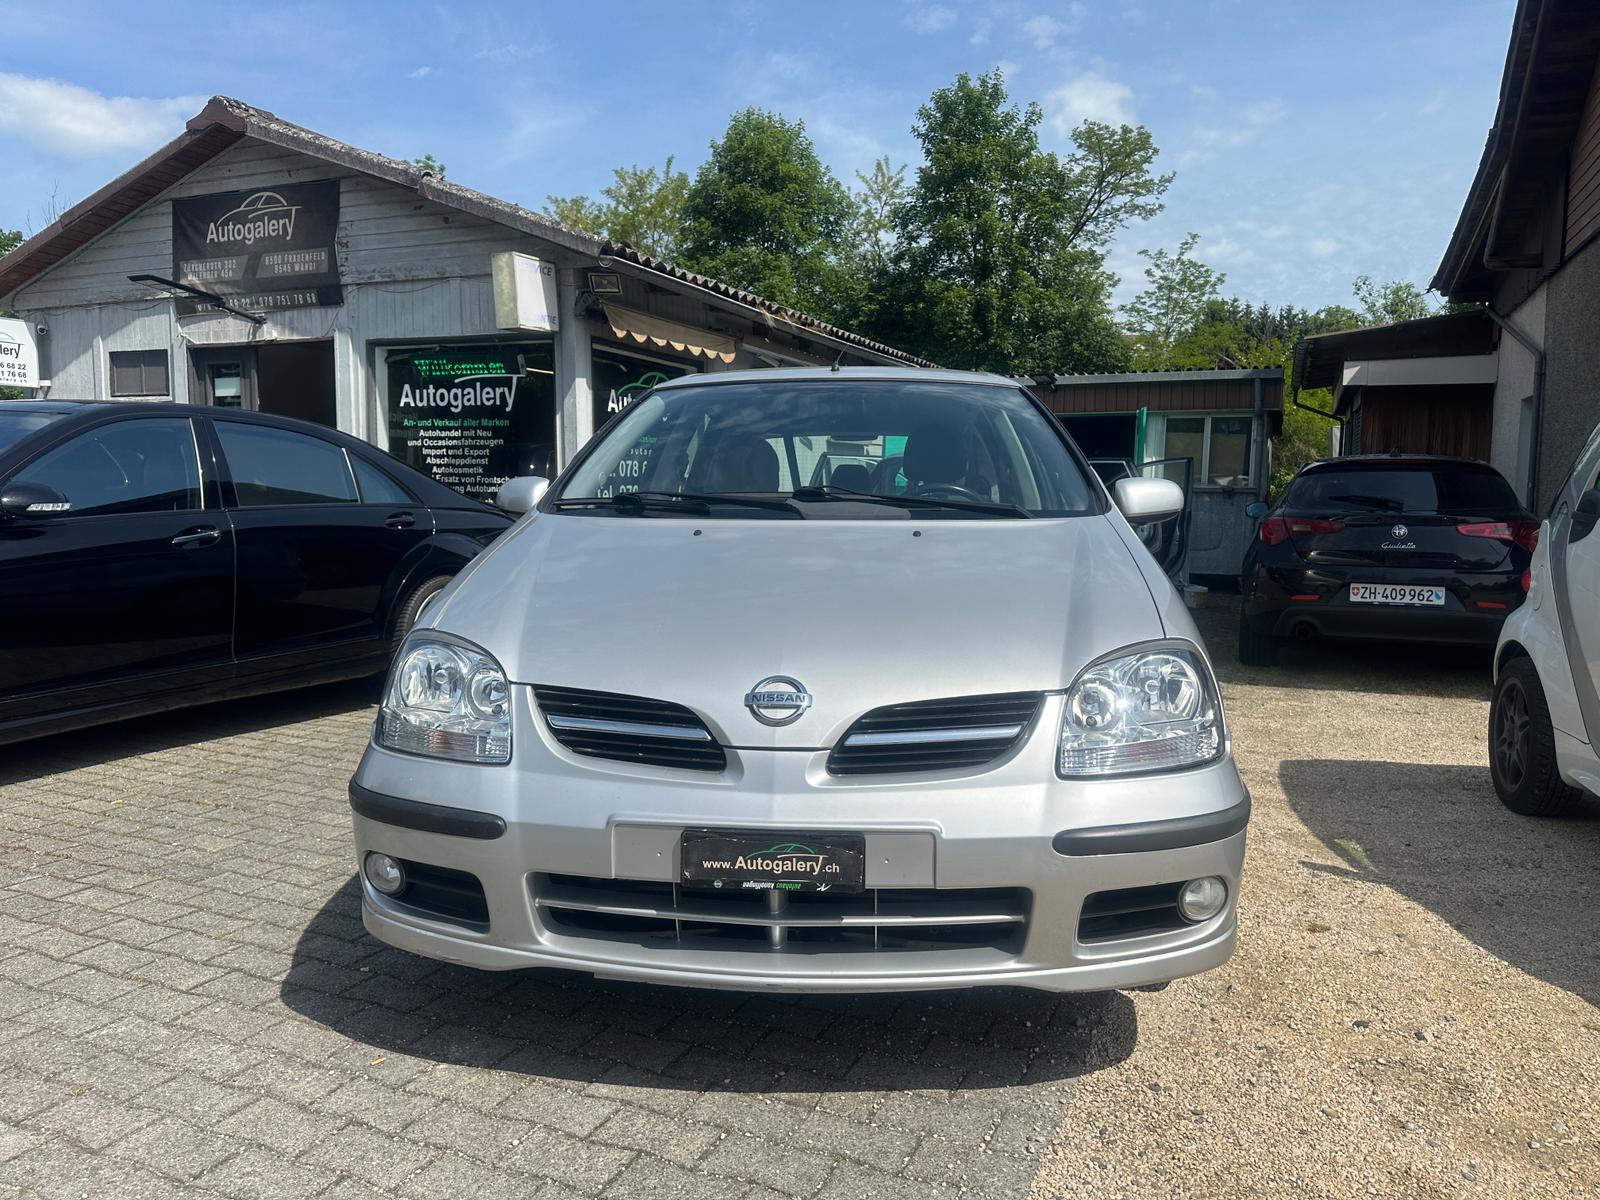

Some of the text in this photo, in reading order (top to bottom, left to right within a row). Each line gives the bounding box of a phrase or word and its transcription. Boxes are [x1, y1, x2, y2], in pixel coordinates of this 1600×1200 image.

[206, 207, 296, 244] Autogalery
[277, 295, 291, 306] 751
[399, 376, 518, 413] Autogalery
[402, 418, 510, 427] An- und Verkauf aller Marken
[419, 429, 462, 437] Autohandel
[423, 438, 504, 448] Occasionsfahrzeugen
[422, 448, 490, 458] Import und Export
[426, 457, 489, 466] Abschleppdienst
[431, 466, 484, 474] Autokosmetik
[619, 460, 639, 478] 078
[460, 476, 476, 484] von
[476, 474, 512, 485] Frontsch
[1381, 541, 1417, 550] Giulietta
[751, 693, 806, 703] NISSAN
[702, 855, 840, 876] www.Autogalery.ch
